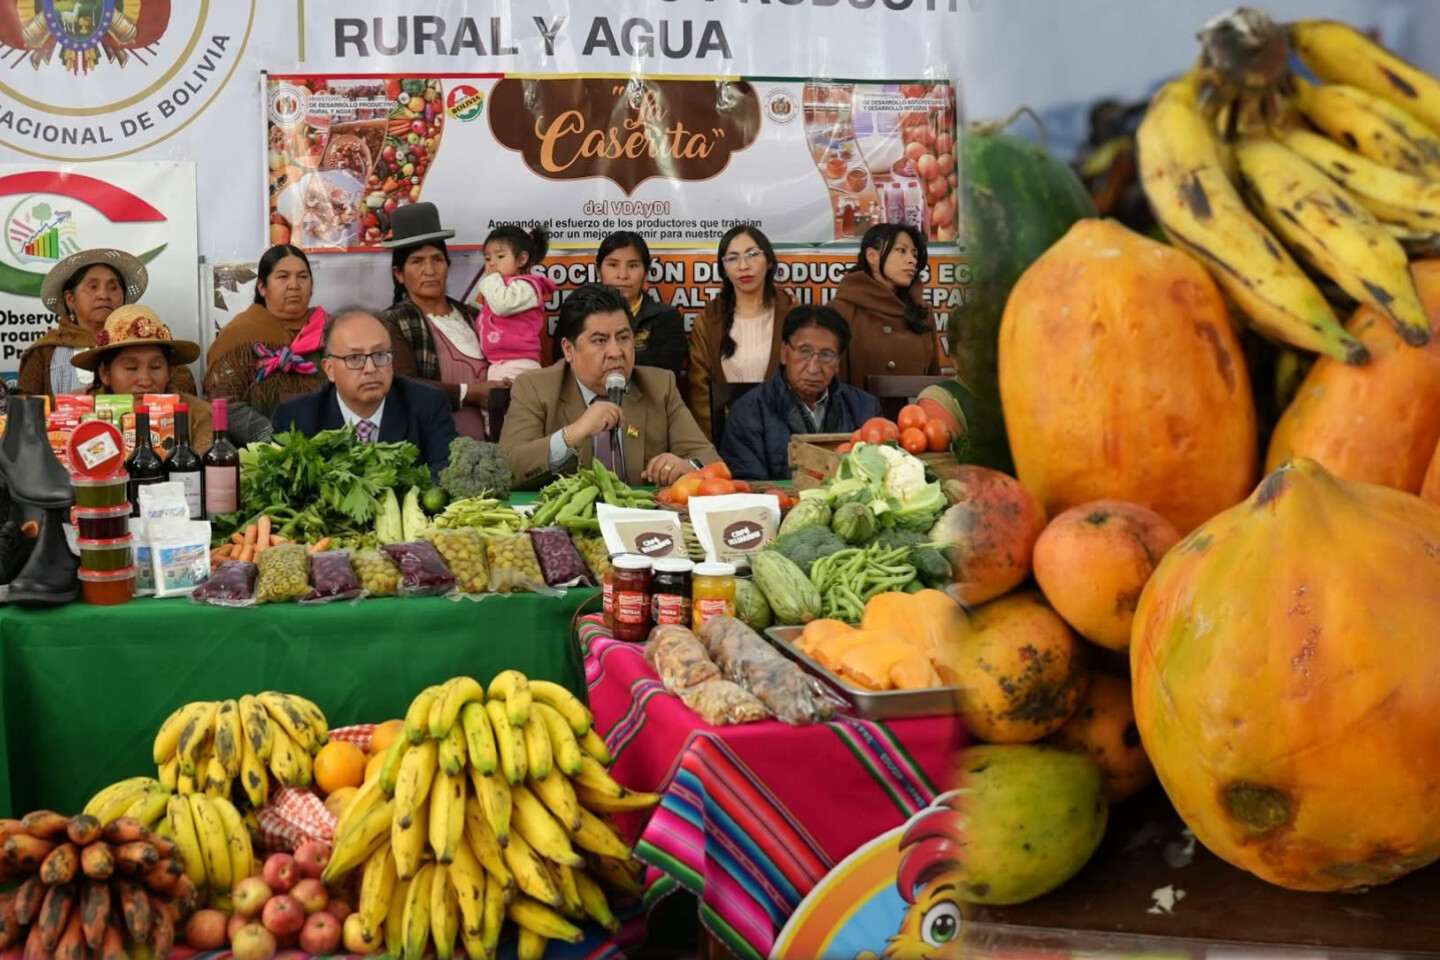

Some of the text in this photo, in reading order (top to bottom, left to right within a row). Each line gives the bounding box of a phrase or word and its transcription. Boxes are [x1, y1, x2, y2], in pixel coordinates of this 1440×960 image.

[335, 16, 733, 59] RURAL Y AGUA
[120, 112, 155, 137] DE
[157, 34, 231, 118] BOLIVIA
[451, 95, 482, 115] BOLIVIA
[583, 200, 608, 215] del
[543, 218, 553, 228] el
[555, 218, 600, 229] esfuerzo
[602, 218, 616, 228] de
[618, 218, 634, 228] los
[635, 218, 698, 230] productores
[700, 220, 719, 230] que
[567, 231, 581, 240] un
[660, 231, 683, 242] para
[685, 230, 725, 240] nuestro
